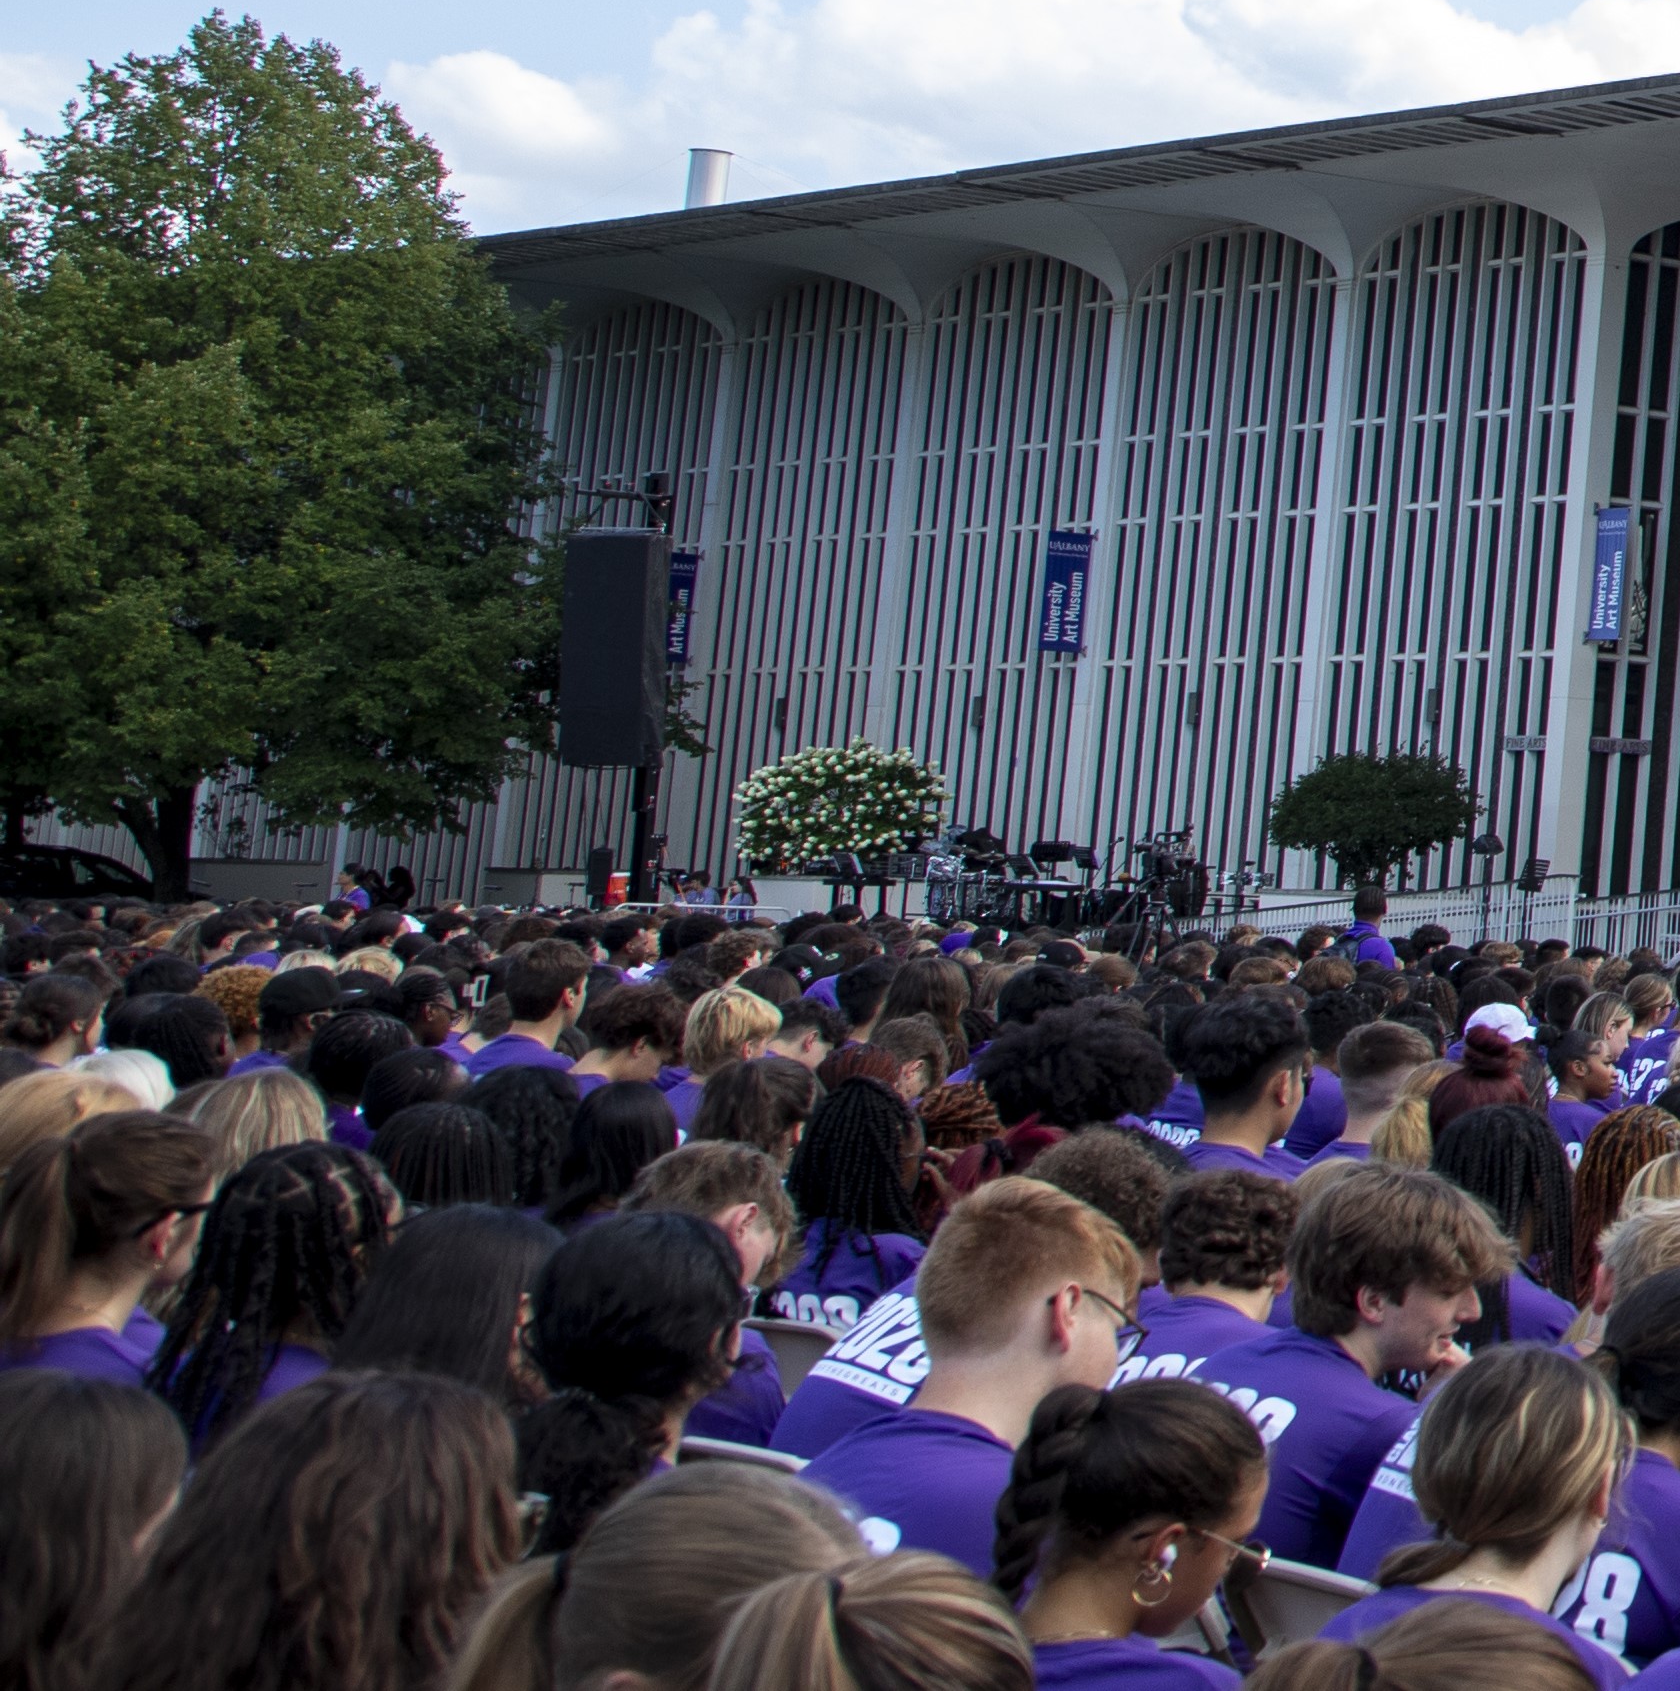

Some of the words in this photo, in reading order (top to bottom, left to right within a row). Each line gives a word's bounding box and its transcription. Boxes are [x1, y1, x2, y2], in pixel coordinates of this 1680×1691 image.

[1064, 571, 1084, 622] Museum
[1608, 551, 1623, 606] Museum
[1043, 581, 1067, 642] University
[1592, 564, 1611, 630] University
[1062, 624, 1079, 644] Art
[1605, 609, 1618, 630] Art
[668, 636, 686, 654] Art
[1506, 738, 1525, 749] FINE
[1526, 736, 1547, 749] ARTS
